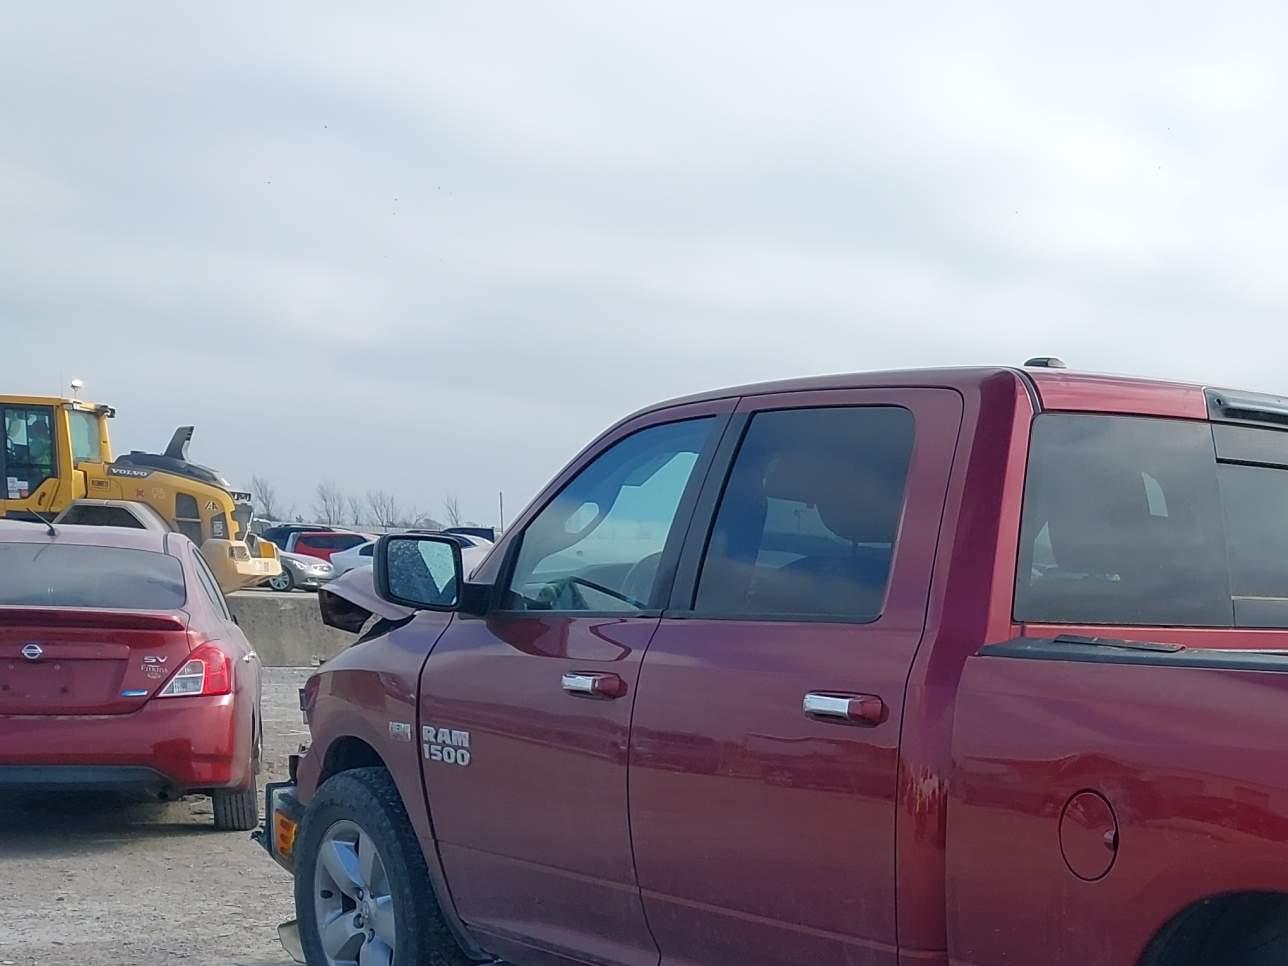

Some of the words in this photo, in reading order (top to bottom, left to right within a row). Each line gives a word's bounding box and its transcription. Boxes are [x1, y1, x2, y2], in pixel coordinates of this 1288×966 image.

[111, 467, 148, 477] VOLVO
[422, 725, 470, 747] RAM
[423, 743, 470, 766] 1500
